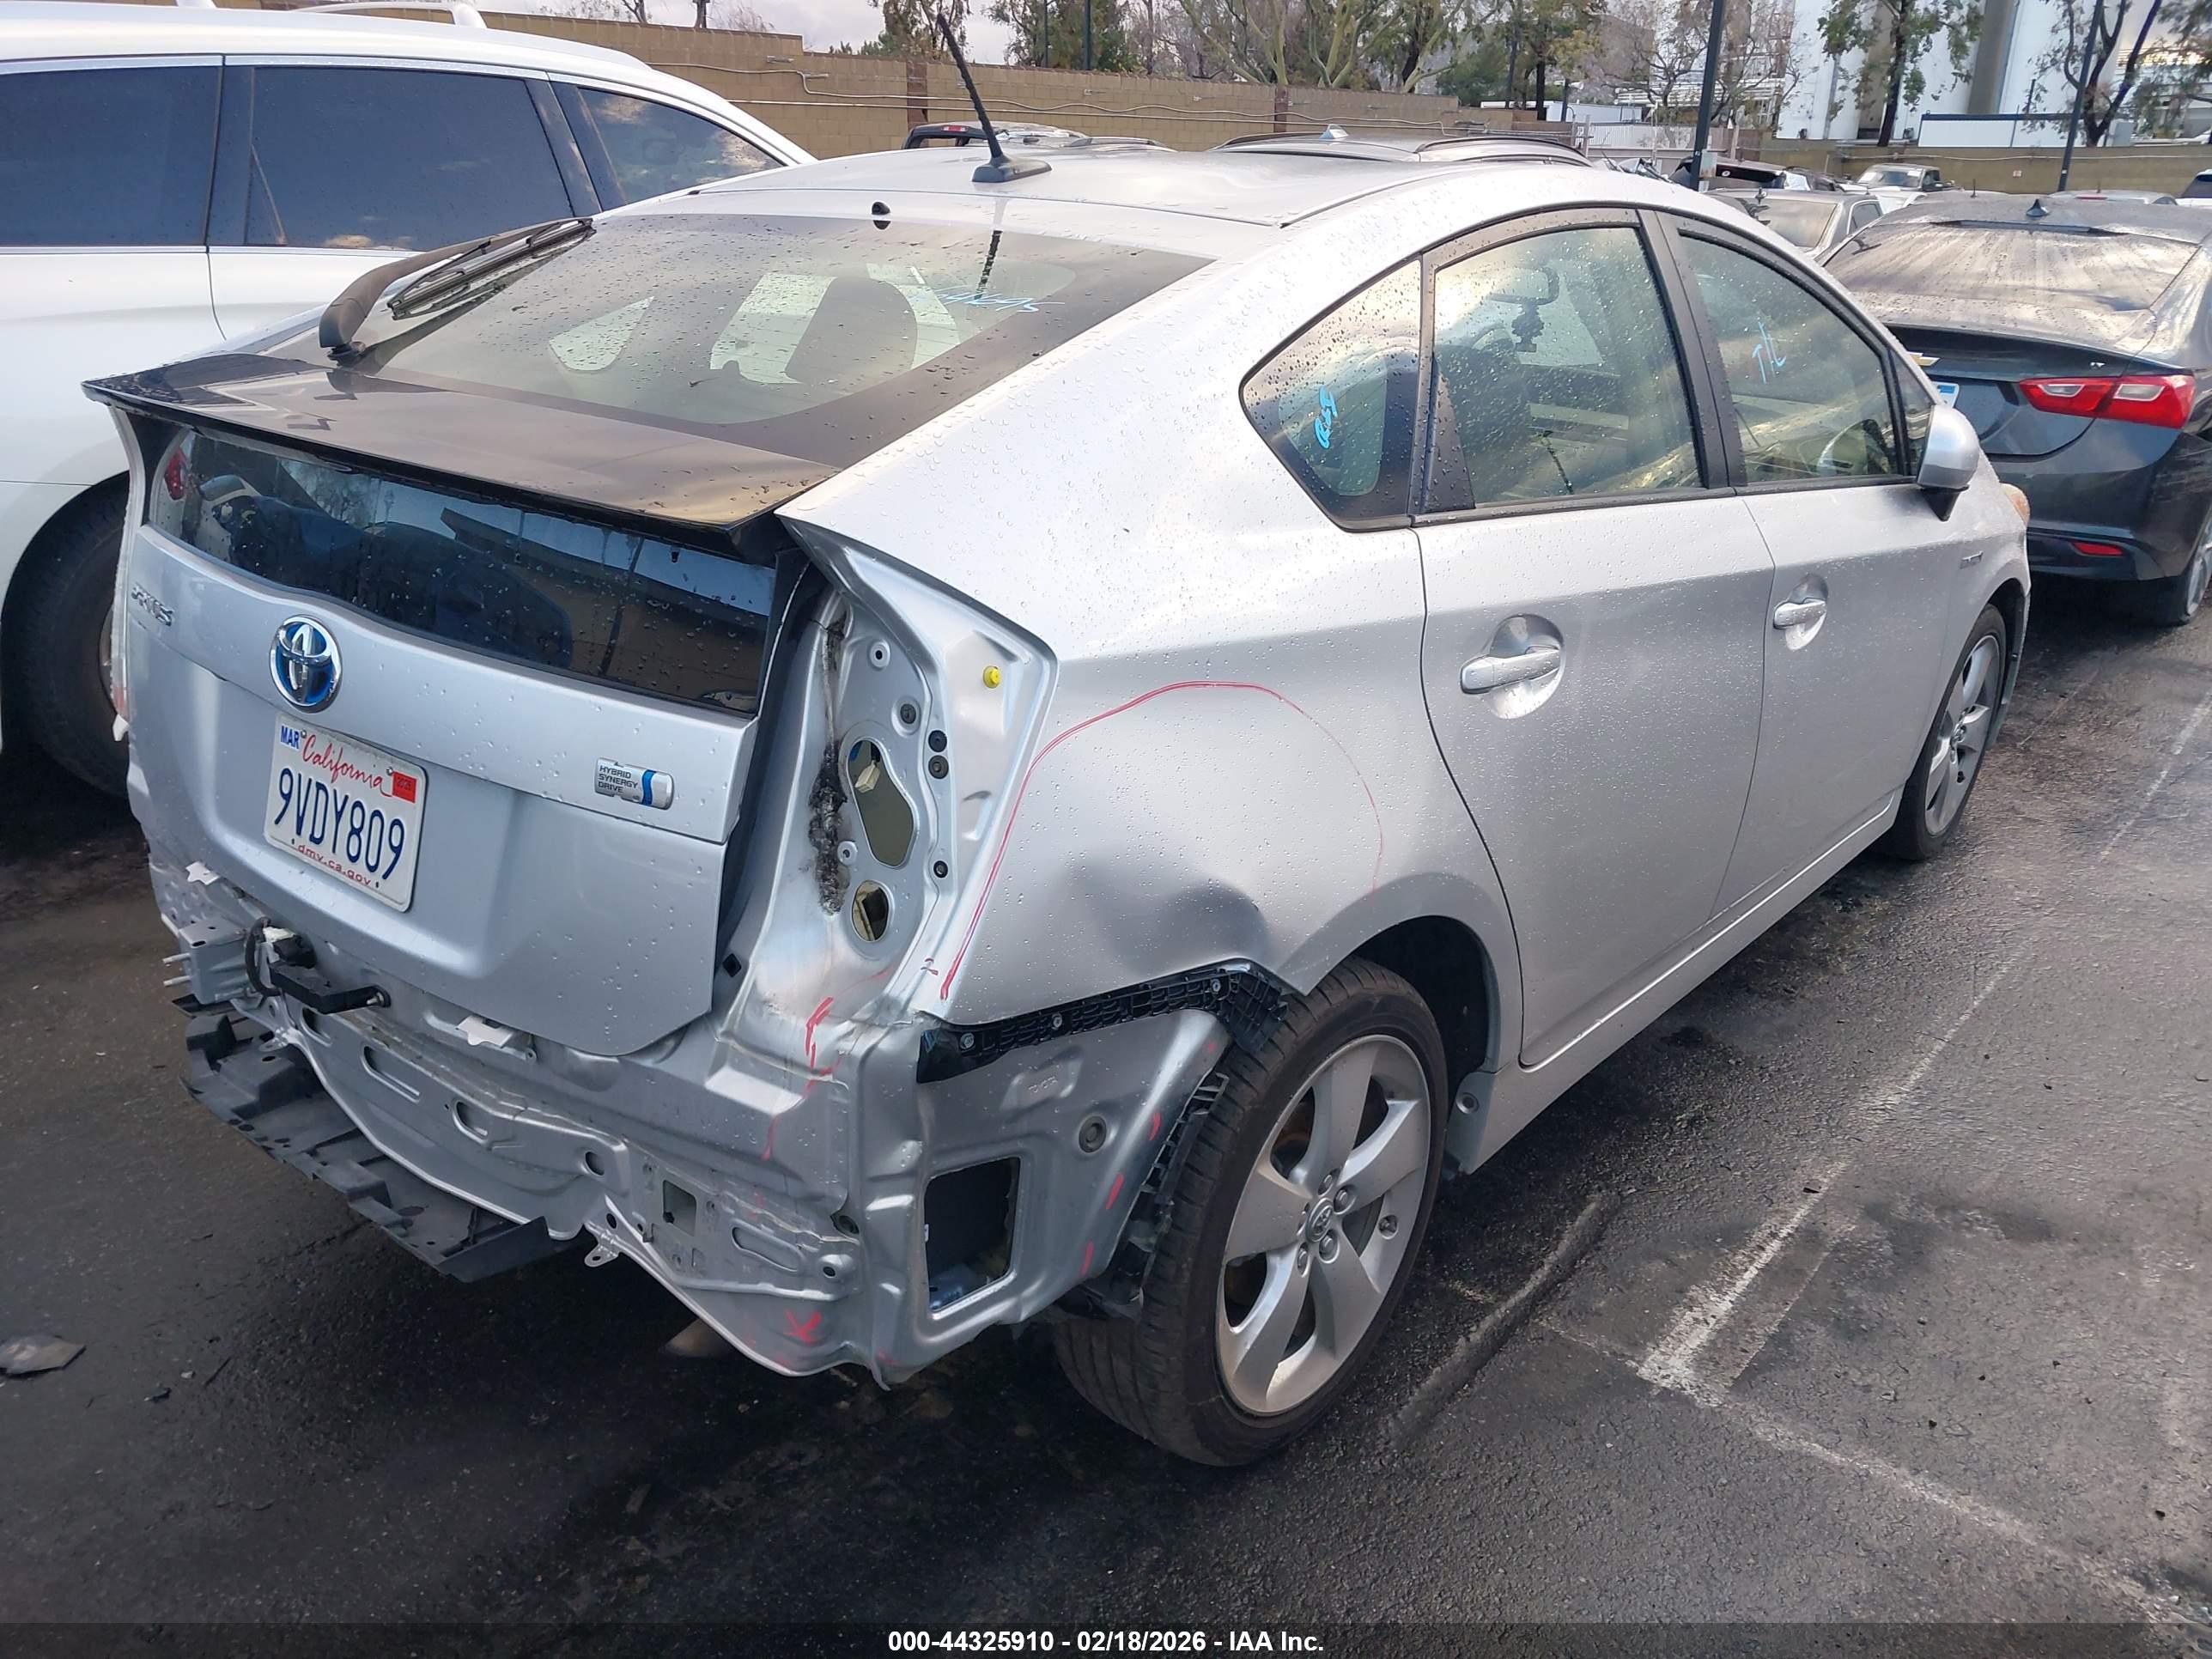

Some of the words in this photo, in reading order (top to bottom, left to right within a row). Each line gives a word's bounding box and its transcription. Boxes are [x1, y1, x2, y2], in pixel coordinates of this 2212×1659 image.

[281, 726, 300, 750] MAR
[302, 734, 392, 797] California
[599, 765, 631, 779] HYBRID
[599, 774, 638, 788] SYNERGY
[599, 781, 623, 793] DRIVE
[274, 768, 405, 880] 9VDY809
[297, 844, 371, 886] dmv.ca.gov
